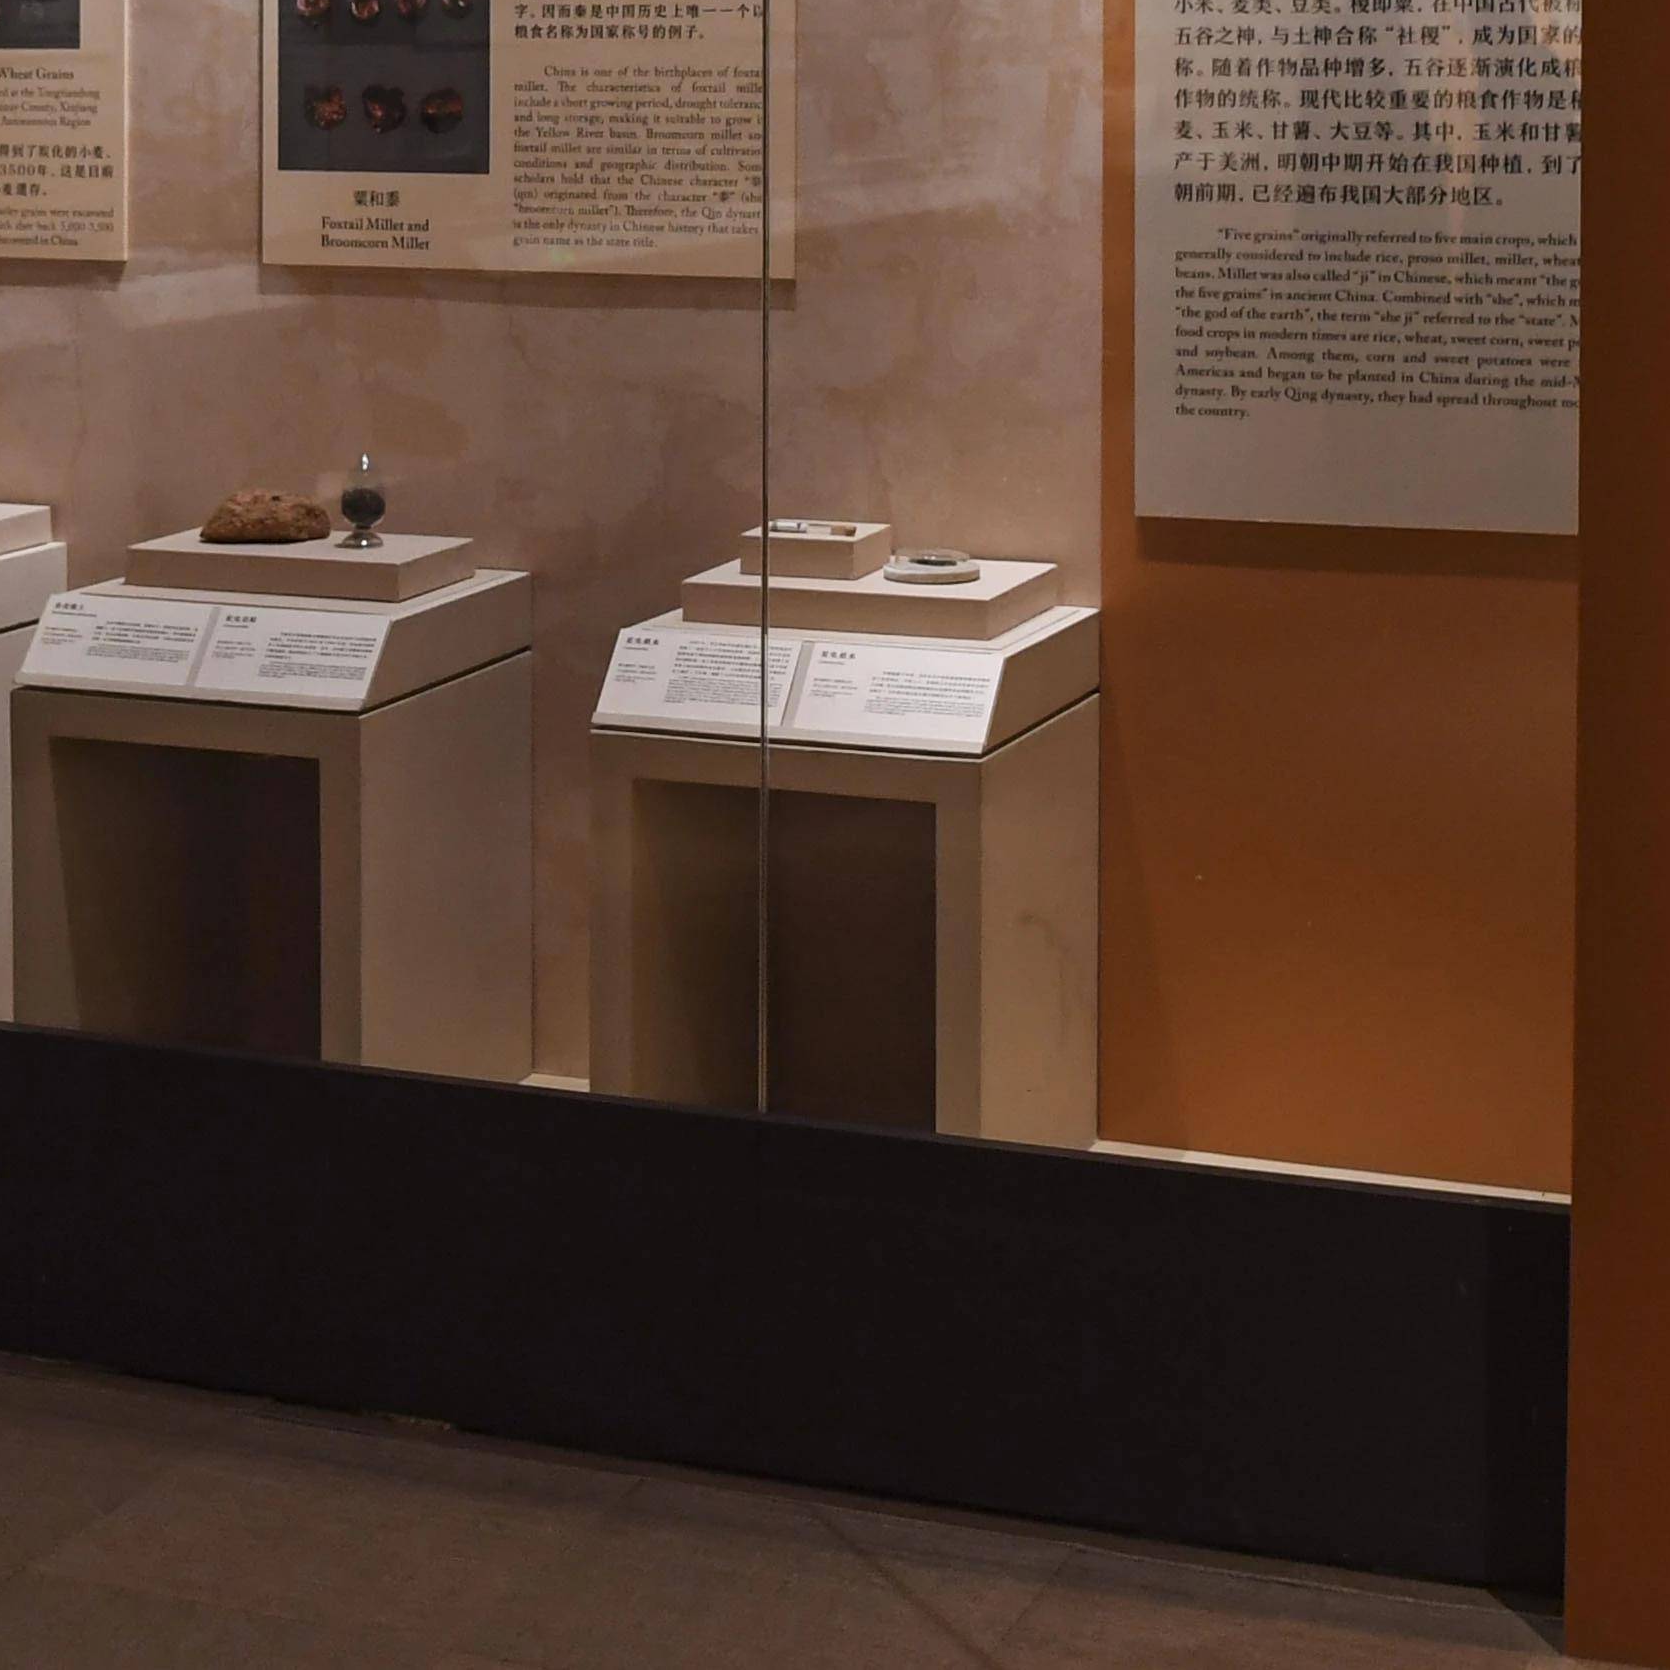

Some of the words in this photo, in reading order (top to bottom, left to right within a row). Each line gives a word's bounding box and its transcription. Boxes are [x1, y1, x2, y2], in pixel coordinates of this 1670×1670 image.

[36, 66, 74, 80] Grains
[1175, 181, 1502, 207] 朝前期，已经遍布我国大部分地区。
[322, 216, 363, 232] Foxtail
[365, 216, 404, 232] Millet
[407, 218, 429, 232] and
[321, 233, 388, 250] Broomcorn
[391, 234, 429, 251] Millet
[1175, 246, 1232, 263] generally
[1236, 248, 1304, 262] considered
[1308, 251, 1321, 262] to
[1325, 248, 1371, 263] include
[1376, 252, 1403, 265] rice,
[1447, 251, 1490, 266] millet,
[1495, 253, 1538, 269] millet,
[1175, 344, 1198, 358] and
[1267, 346, 1314, 365] Among
[1322, 348, 1359, 363] them,
[1366, 353, 1395, 363] corn
[1403, 351, 1426, 364] and
[1434, 355, 1469, 366] sweet
[1477, 356, 1532, 370] potatoes
[1539, 357, 1570, 369] were
